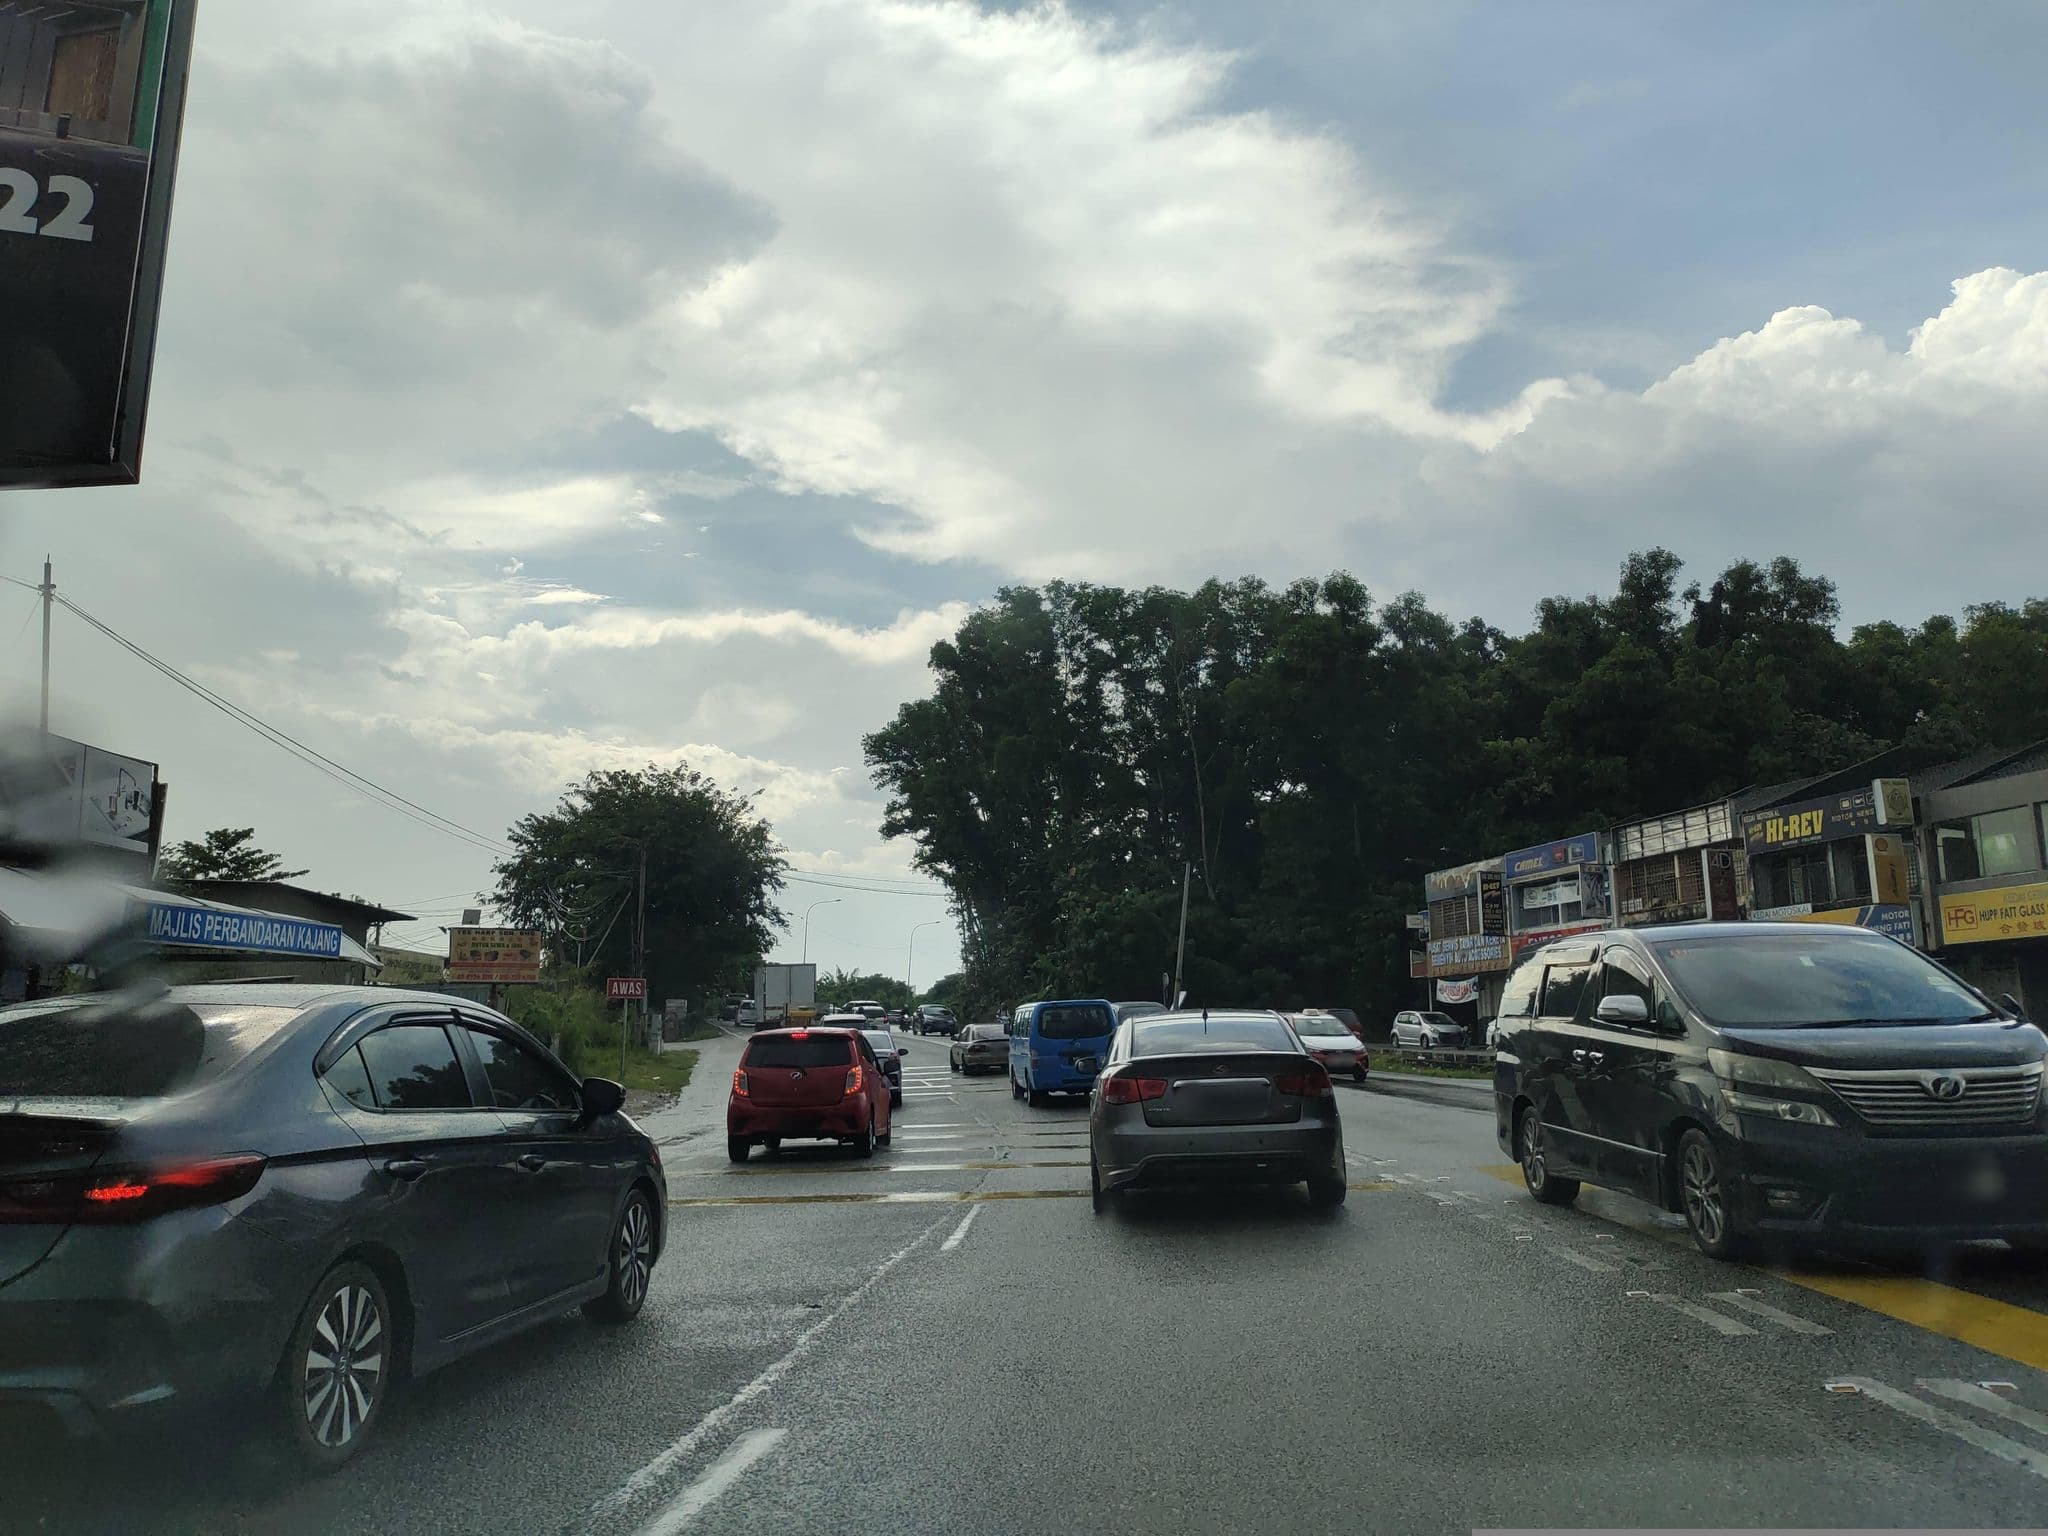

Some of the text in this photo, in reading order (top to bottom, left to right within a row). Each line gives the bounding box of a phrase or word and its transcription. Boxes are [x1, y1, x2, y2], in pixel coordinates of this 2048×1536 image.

[1765, 809, 1824, 844] HI-REV
[1711, 852, 1731, 869] 4D
[1752, 904, 1811, 920] KEDAI MOTOSIKAL
[1881, 910, 1910, 921] MOTOR
[1947, 907, 1976, 928] HFG
[1999, 906, 2017, 920] FATT
[2019, 902, 2046, 917] GLASS
[150, 908, 338, 953] MAJLIS PERBANDARAN KAJANG
[612, 982, 642, 995] AWAS
